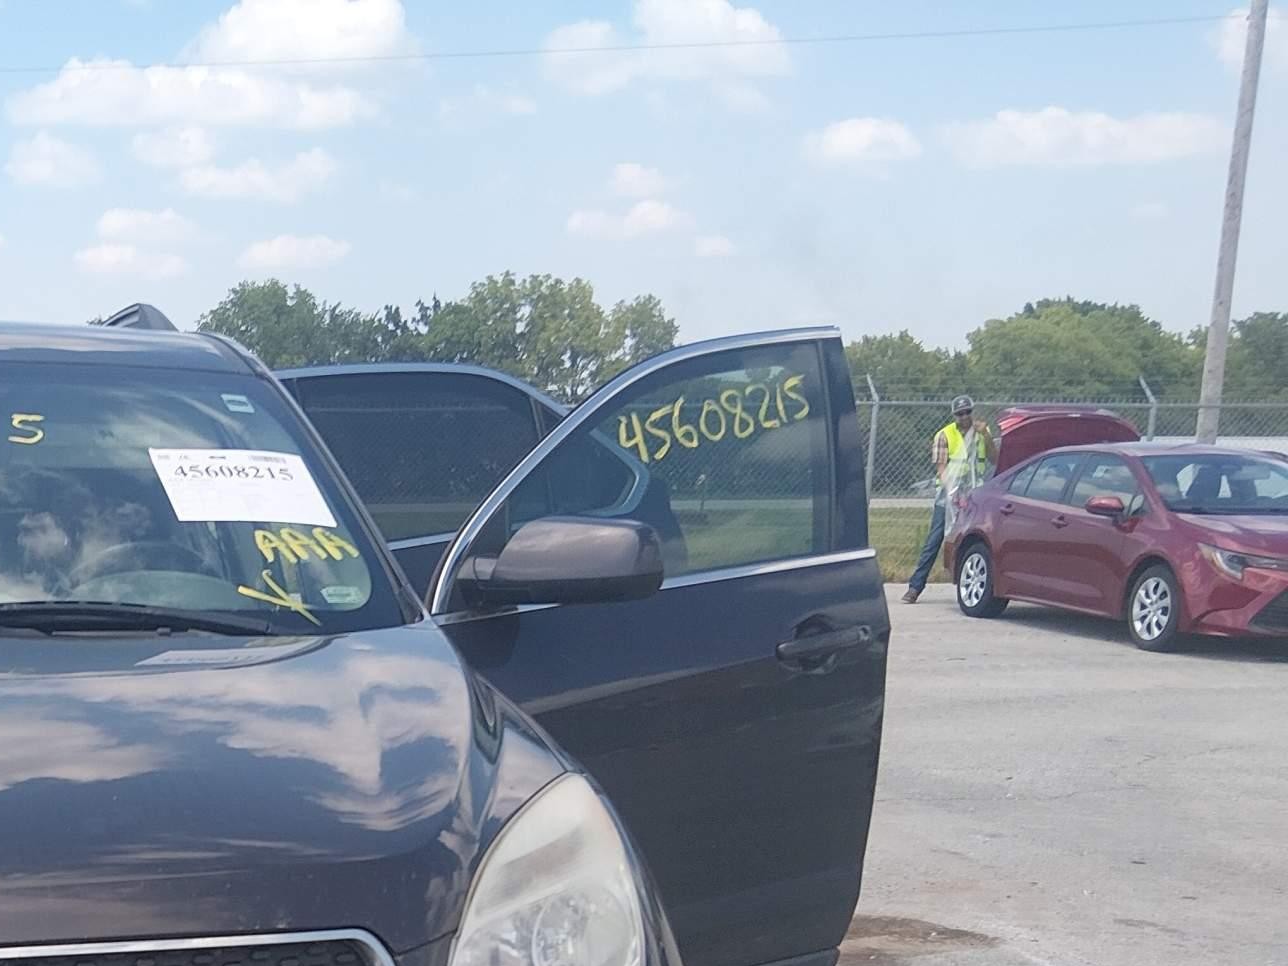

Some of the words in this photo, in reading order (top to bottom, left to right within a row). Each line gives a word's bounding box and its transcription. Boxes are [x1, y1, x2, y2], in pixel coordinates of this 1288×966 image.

[617, 373, 810, 464] 45608215
[174, 464, 294, 481] 45608215
[253, 527, 360, 563] AAA
